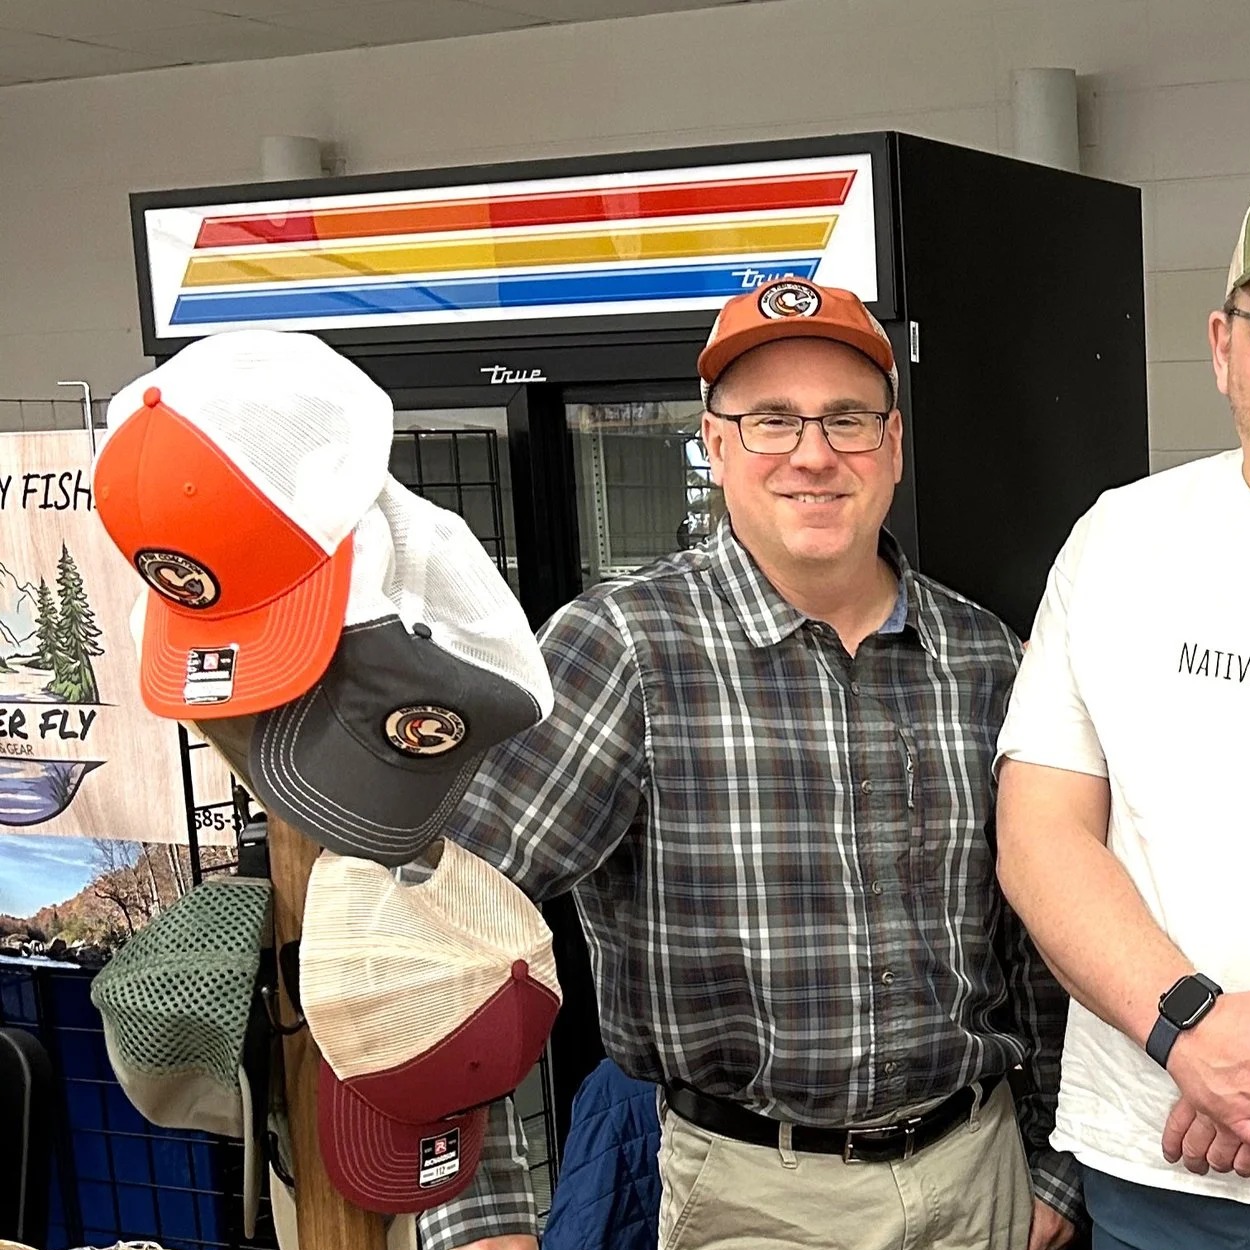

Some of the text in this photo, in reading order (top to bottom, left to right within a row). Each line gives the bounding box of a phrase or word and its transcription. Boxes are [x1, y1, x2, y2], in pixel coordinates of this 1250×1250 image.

[480, 365, 547, 383] true
[40, 708, 97, 741] FLY
[7, 742, 34, 756] GEAR
